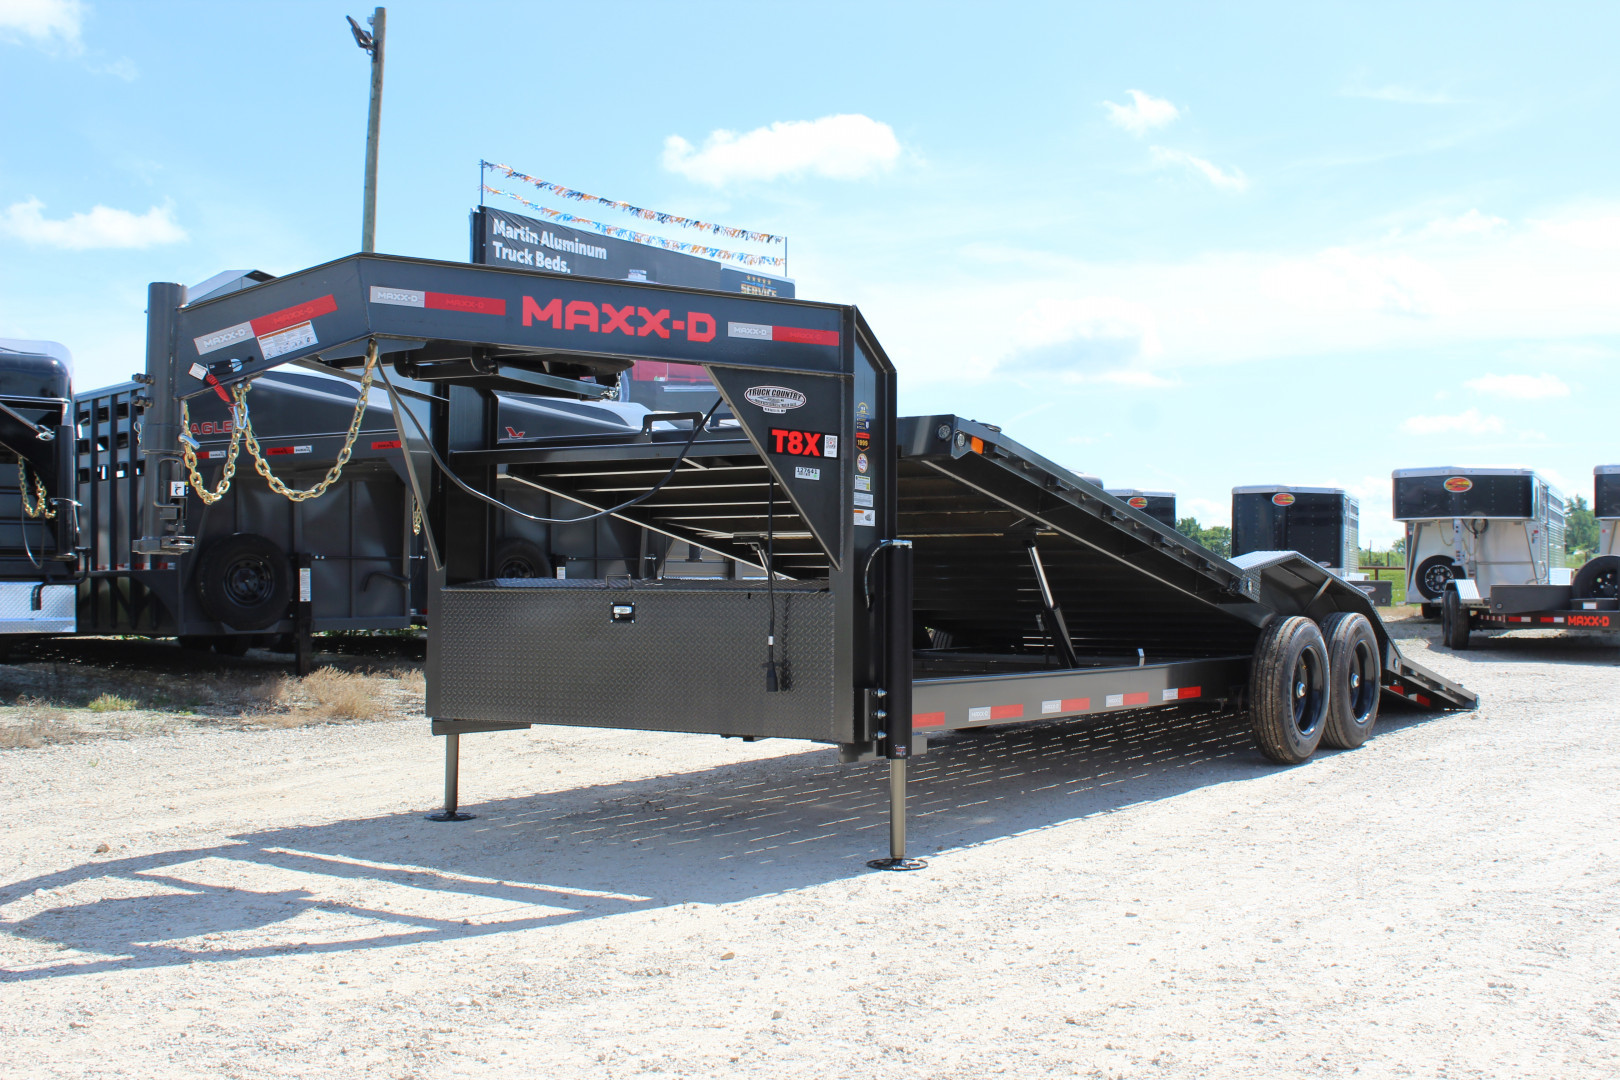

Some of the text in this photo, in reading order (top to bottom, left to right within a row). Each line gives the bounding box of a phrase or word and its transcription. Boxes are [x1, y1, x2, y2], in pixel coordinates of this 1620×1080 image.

[493, 218, 607, 260] Martin Aluminum
[492, 241, 571, 274] Truck Beds.
[522, 295, 717, 343] MAXX-D
[203, 328, 246, 348] MAXX-D
[749, 388, 771, 396] TRUCK
[771, 389, 802, 400] COUNTRY
[190, 420, 233, 435] AGLE
[771, 428, 821, 457] T8X
[1567, 615, 1610, 627] MAXX-D
